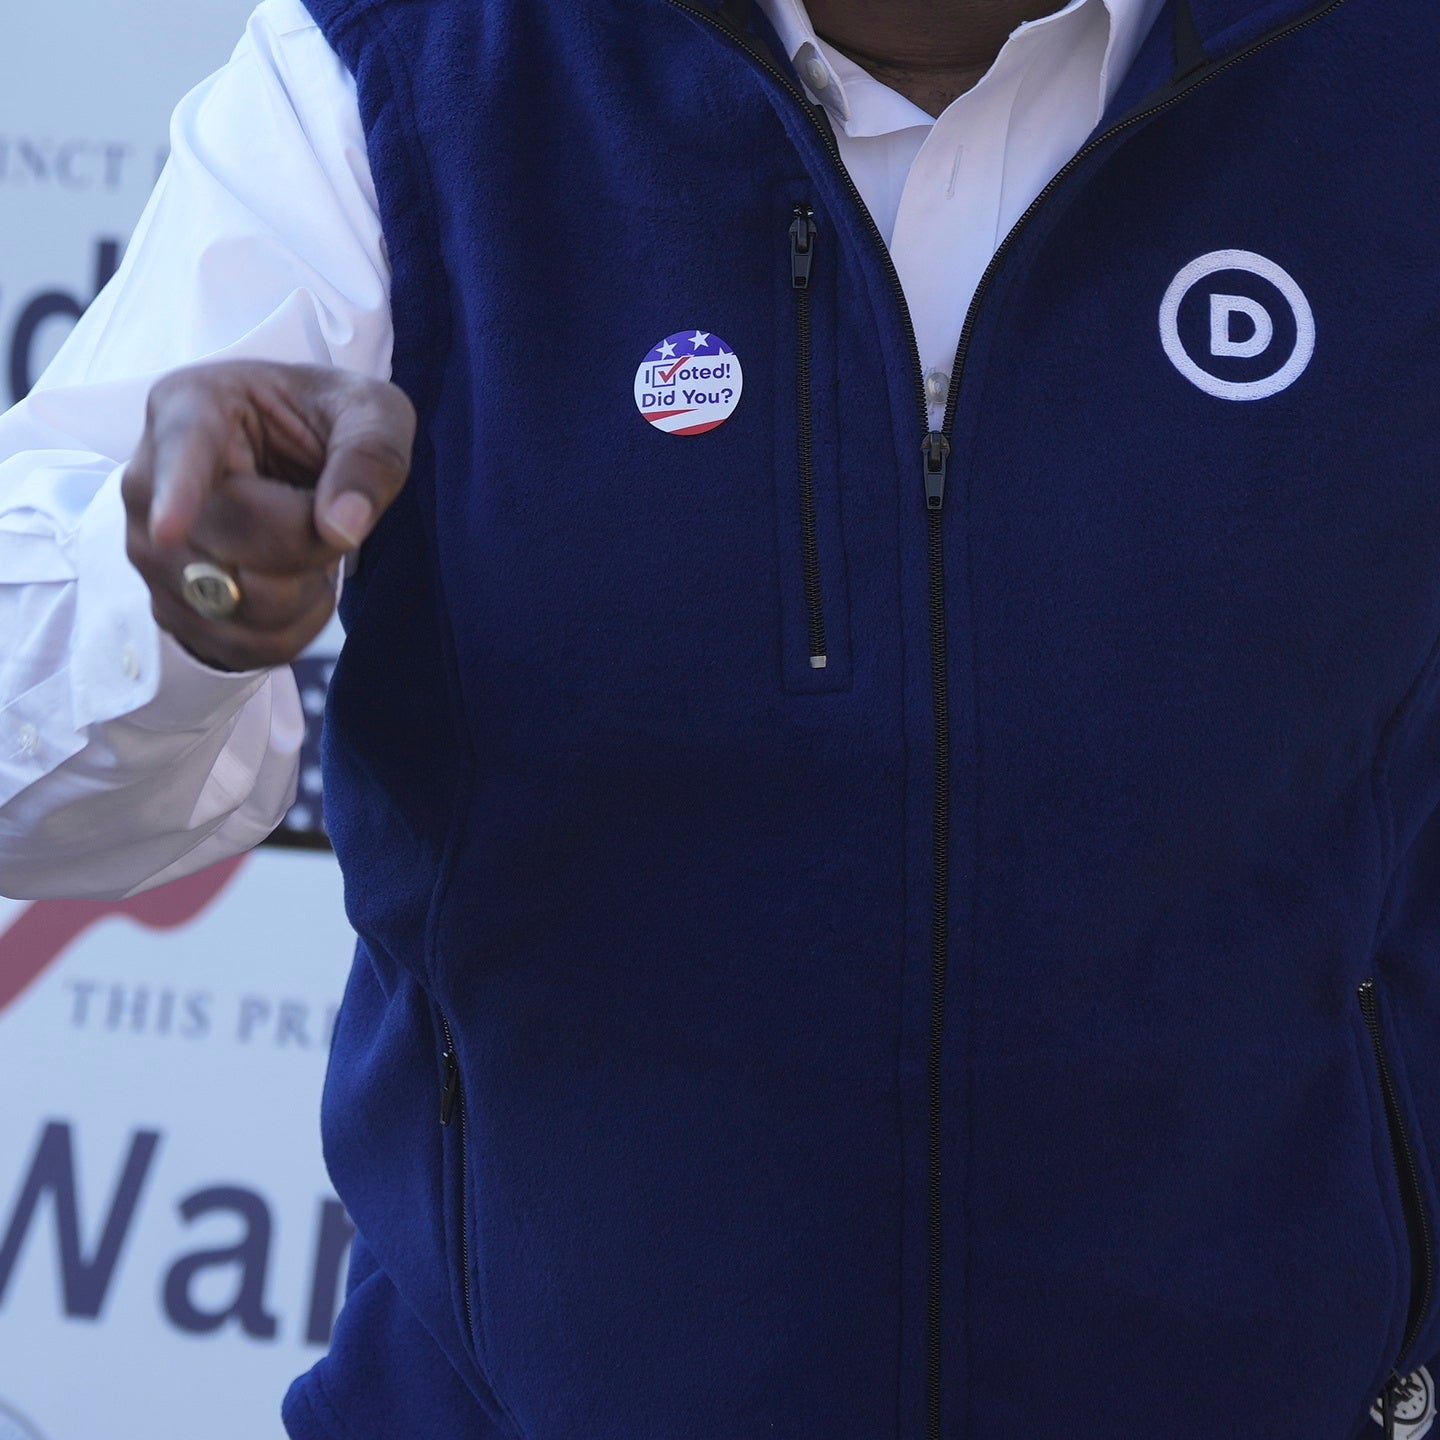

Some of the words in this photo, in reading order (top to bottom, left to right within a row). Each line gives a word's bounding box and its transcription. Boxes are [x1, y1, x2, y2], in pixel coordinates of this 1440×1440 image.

[1210, 294, 1273, 358] D
[642, 390, 676, 408] Did
[682, 388, 733, 405] You?
[66, 981, 210, 1037] THIS
